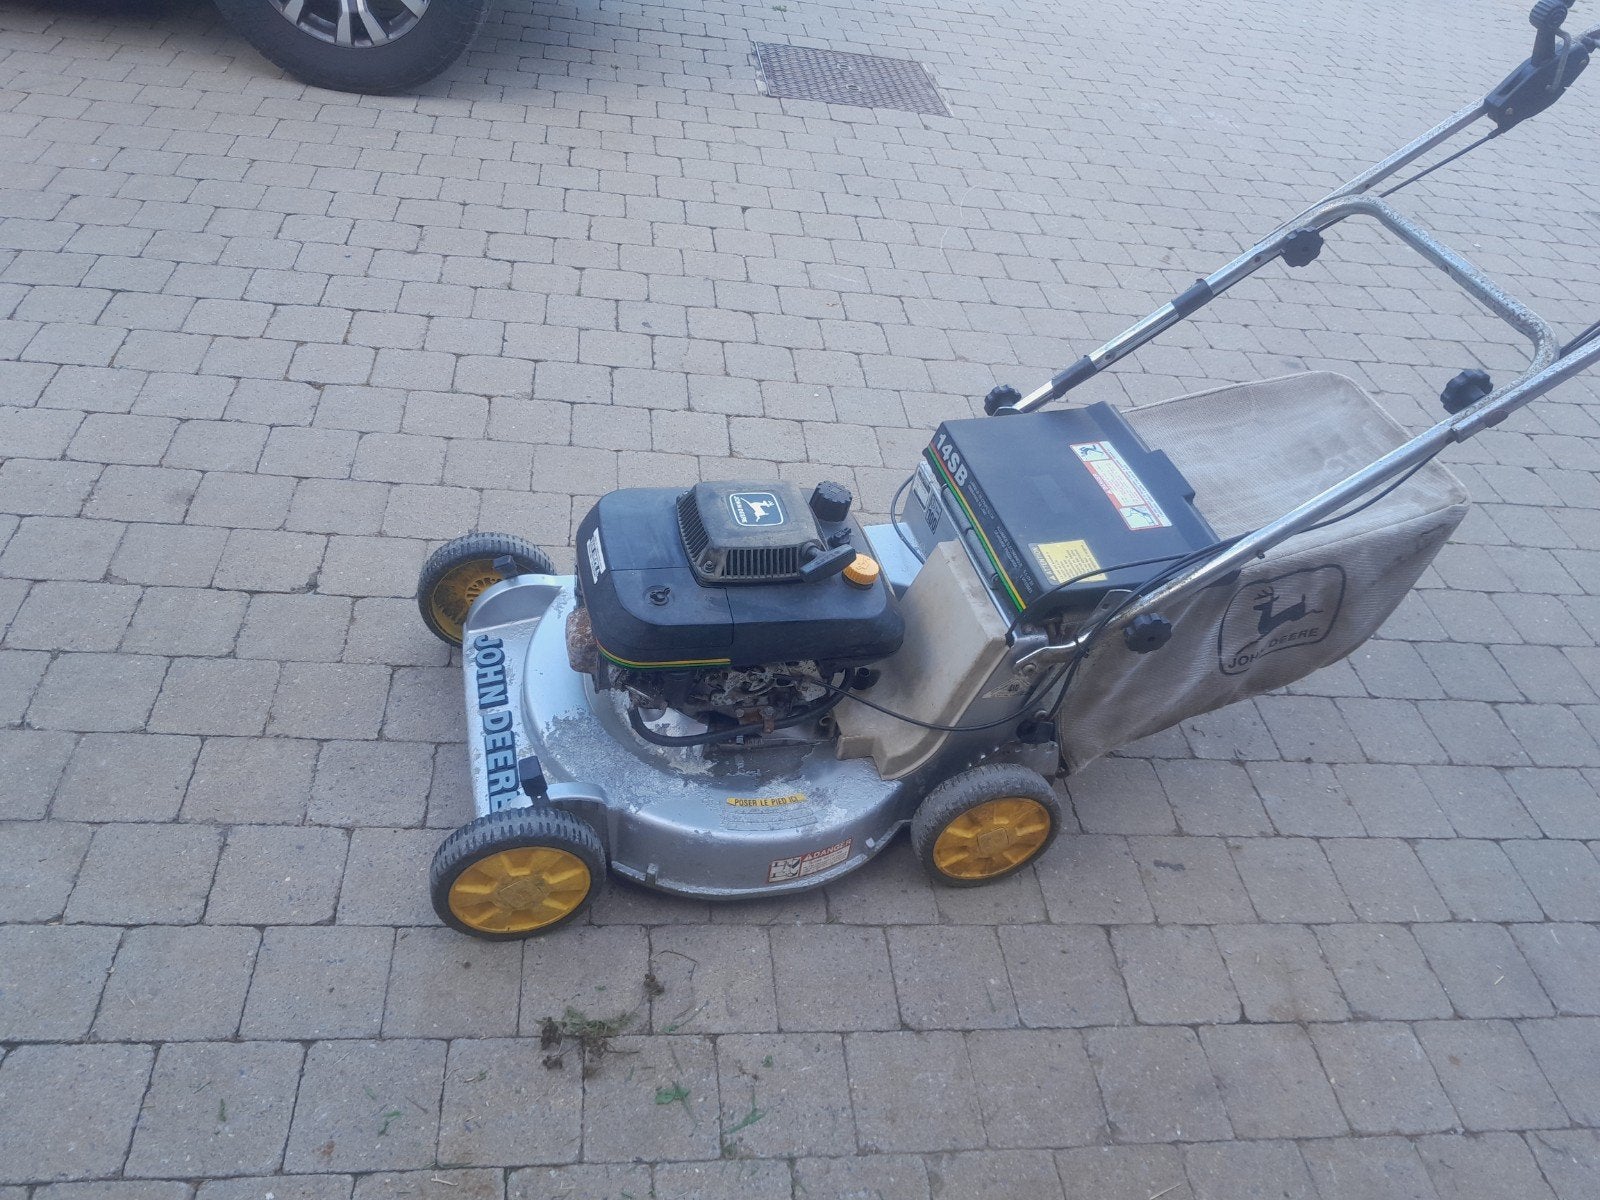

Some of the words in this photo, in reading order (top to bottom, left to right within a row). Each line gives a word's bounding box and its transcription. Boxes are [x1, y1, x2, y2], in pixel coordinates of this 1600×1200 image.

[935, 433, 968, 487] 14SB
[474, 634, 509, 709] JOHN
[734, 799, 759, 807] POSER
[771, 798, 787, 806] PIED
[814, 838, 852, 859] DANGER
